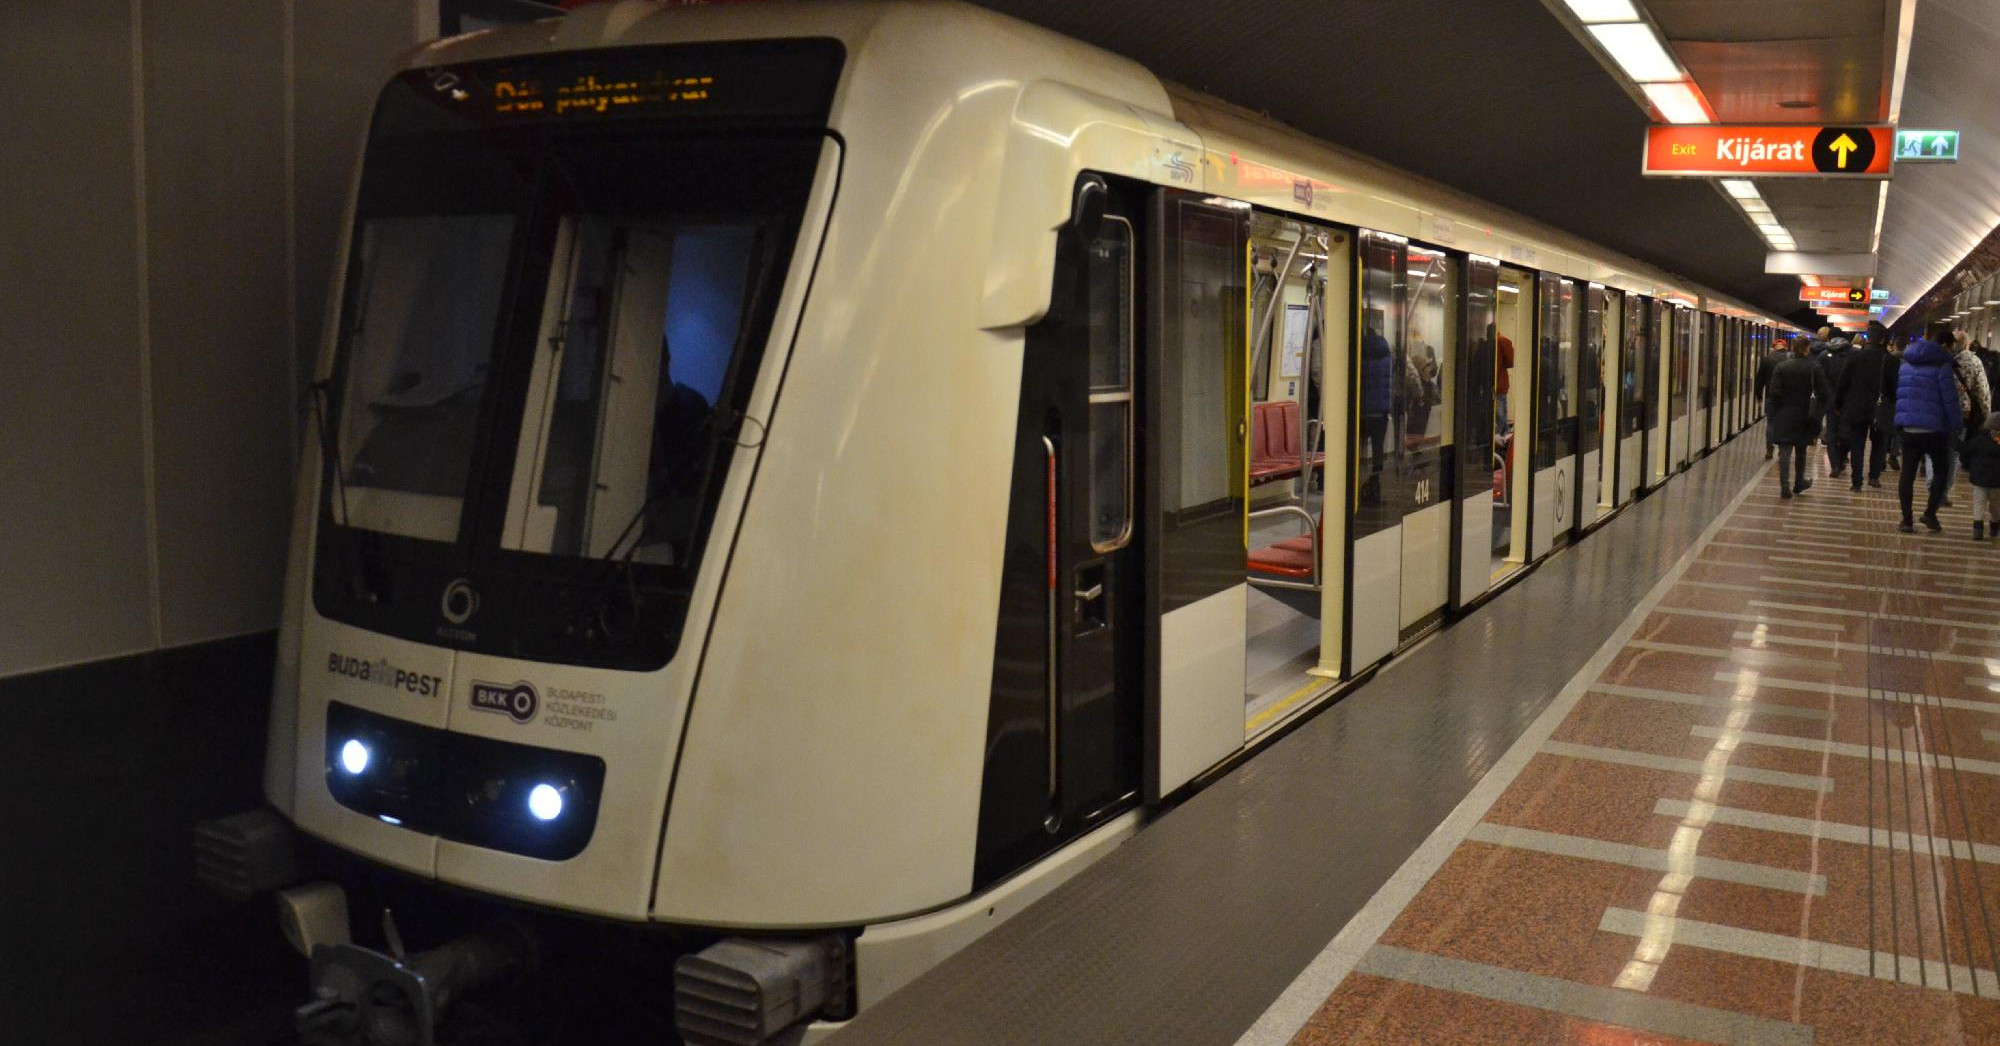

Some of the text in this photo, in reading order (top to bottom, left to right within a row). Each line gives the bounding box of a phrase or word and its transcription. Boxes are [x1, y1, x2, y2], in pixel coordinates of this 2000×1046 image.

[1672, 138, 1804, 165] Exit Kijárat
[1415, 478, 1429, 504] 414
[477, 689, 508, 706] BKK
[546, 686, 606, 703] BUDAPESTI
